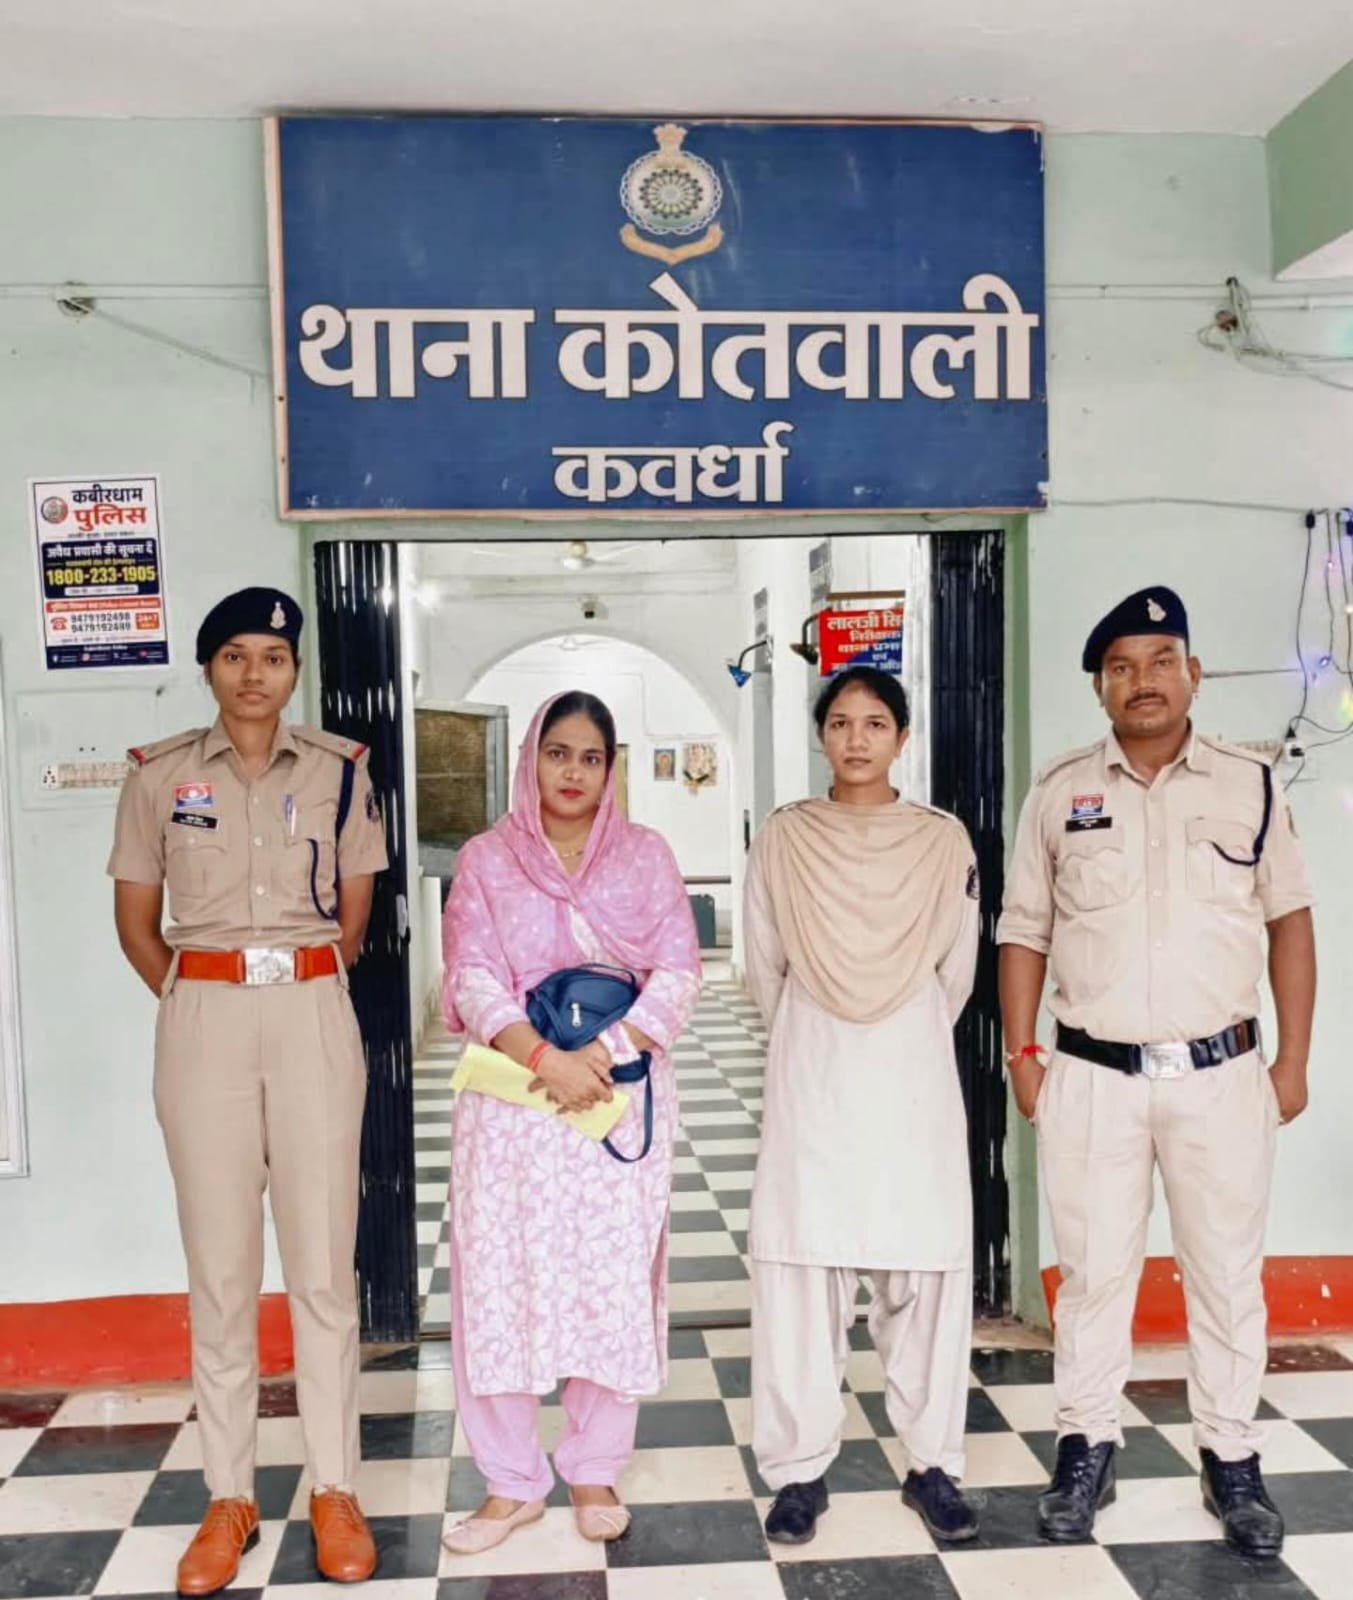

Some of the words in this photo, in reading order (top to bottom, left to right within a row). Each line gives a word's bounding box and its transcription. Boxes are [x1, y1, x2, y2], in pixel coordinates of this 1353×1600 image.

[299, 303, 535, 399] थाना
[553, 271, 1039, 400] कोतवाली
[552, 420, 795, 503] कवर्धा
[72, 484, 143, 504] कबीरधाम
[74, 503, 147, 532] पुलिस
[104, 541, 116, 555] की
[46, 565, 156, 586] 1800-233-1905
[827, 611, 880, 630] लालजी
